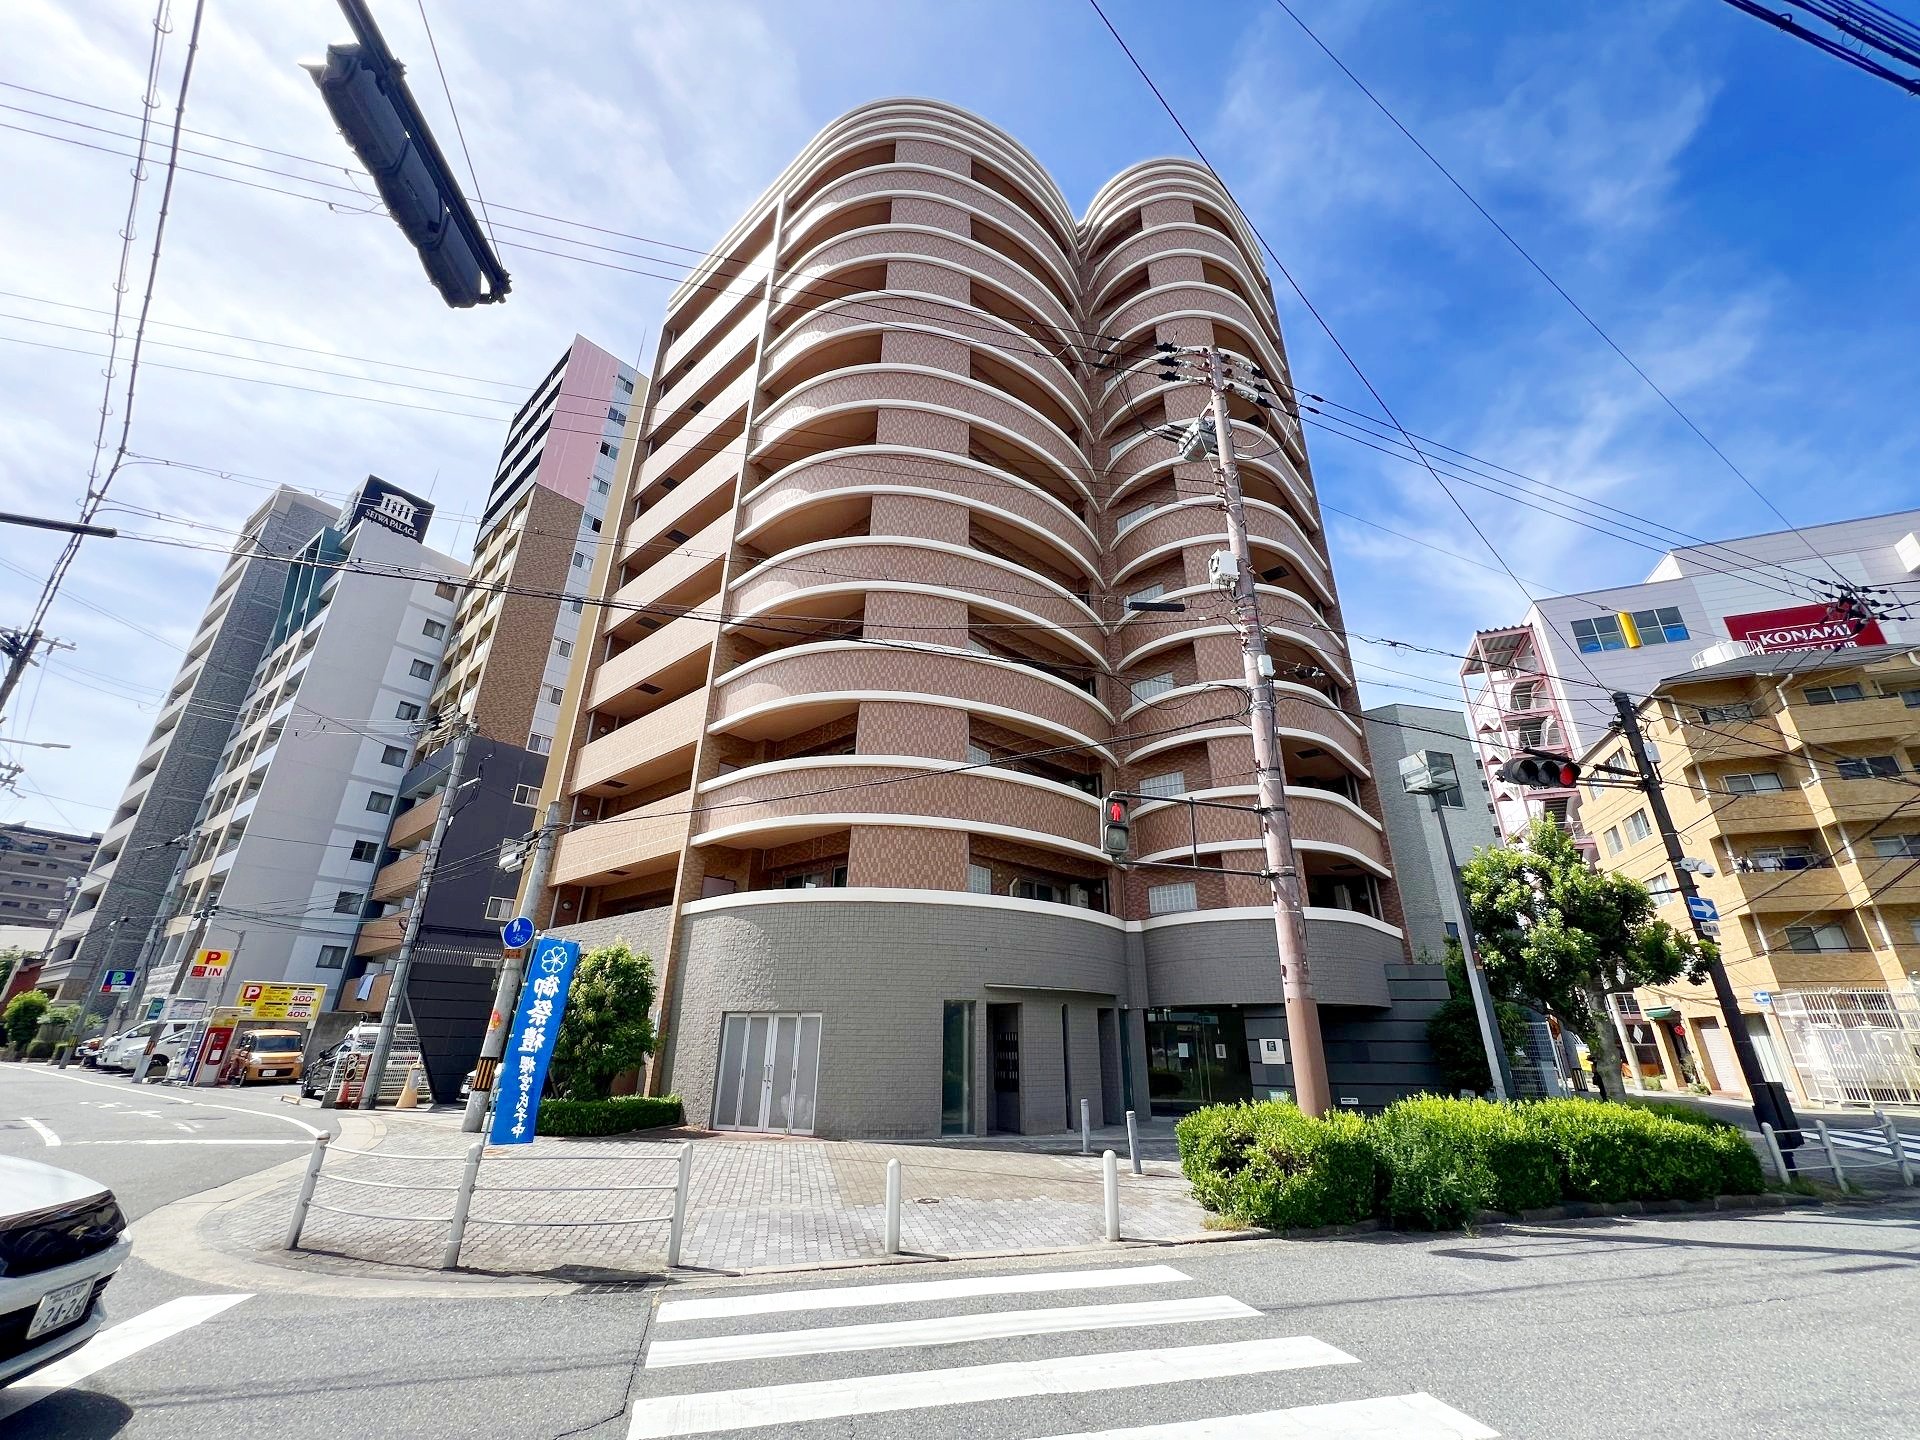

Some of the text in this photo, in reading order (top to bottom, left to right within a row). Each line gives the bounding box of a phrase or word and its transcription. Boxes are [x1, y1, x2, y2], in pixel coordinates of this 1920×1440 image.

[364, 508, 419, 537] SEIWA PALACE
[1759, 623, 1852, 646] KONAMI
[204, 951, 222, 965] P
[208, 967, 222, 976] IN
[244, 985, 261, 1000] P
